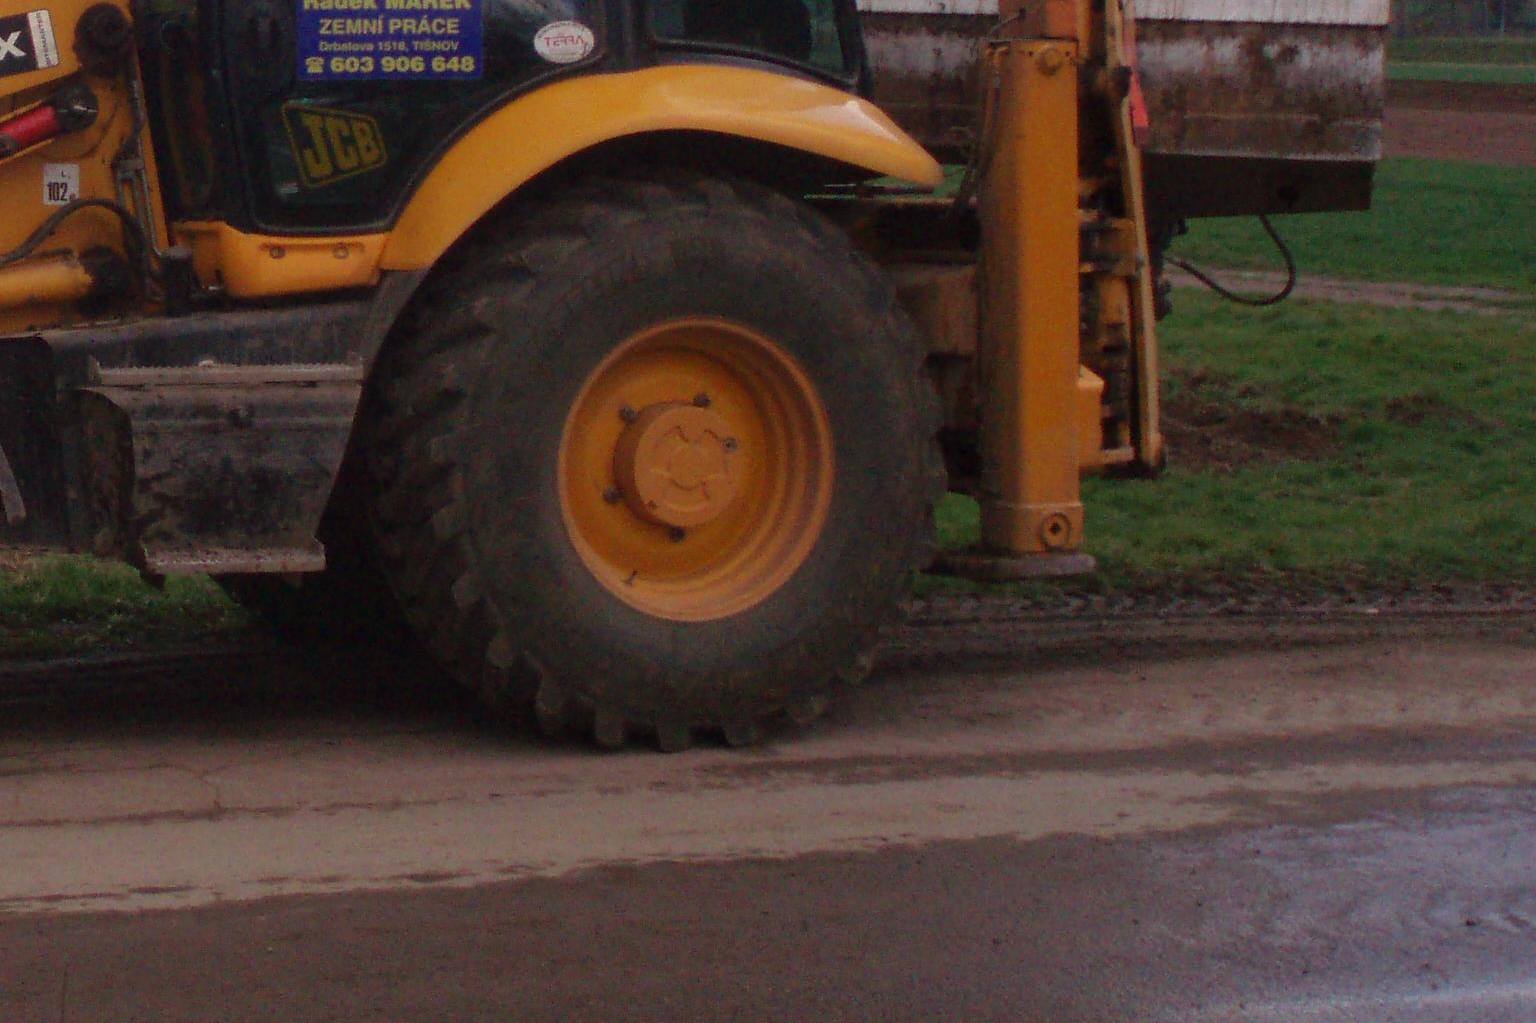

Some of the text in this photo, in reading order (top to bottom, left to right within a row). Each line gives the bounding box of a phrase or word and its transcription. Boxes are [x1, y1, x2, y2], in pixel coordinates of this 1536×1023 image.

[319, 14, 460, 35] ZEMNÍ PRÁCE
[329, 56, 476, 73] 603 906 648
[300, 112, 383, 178] JCB
[47, 181, 68, 202] 102
